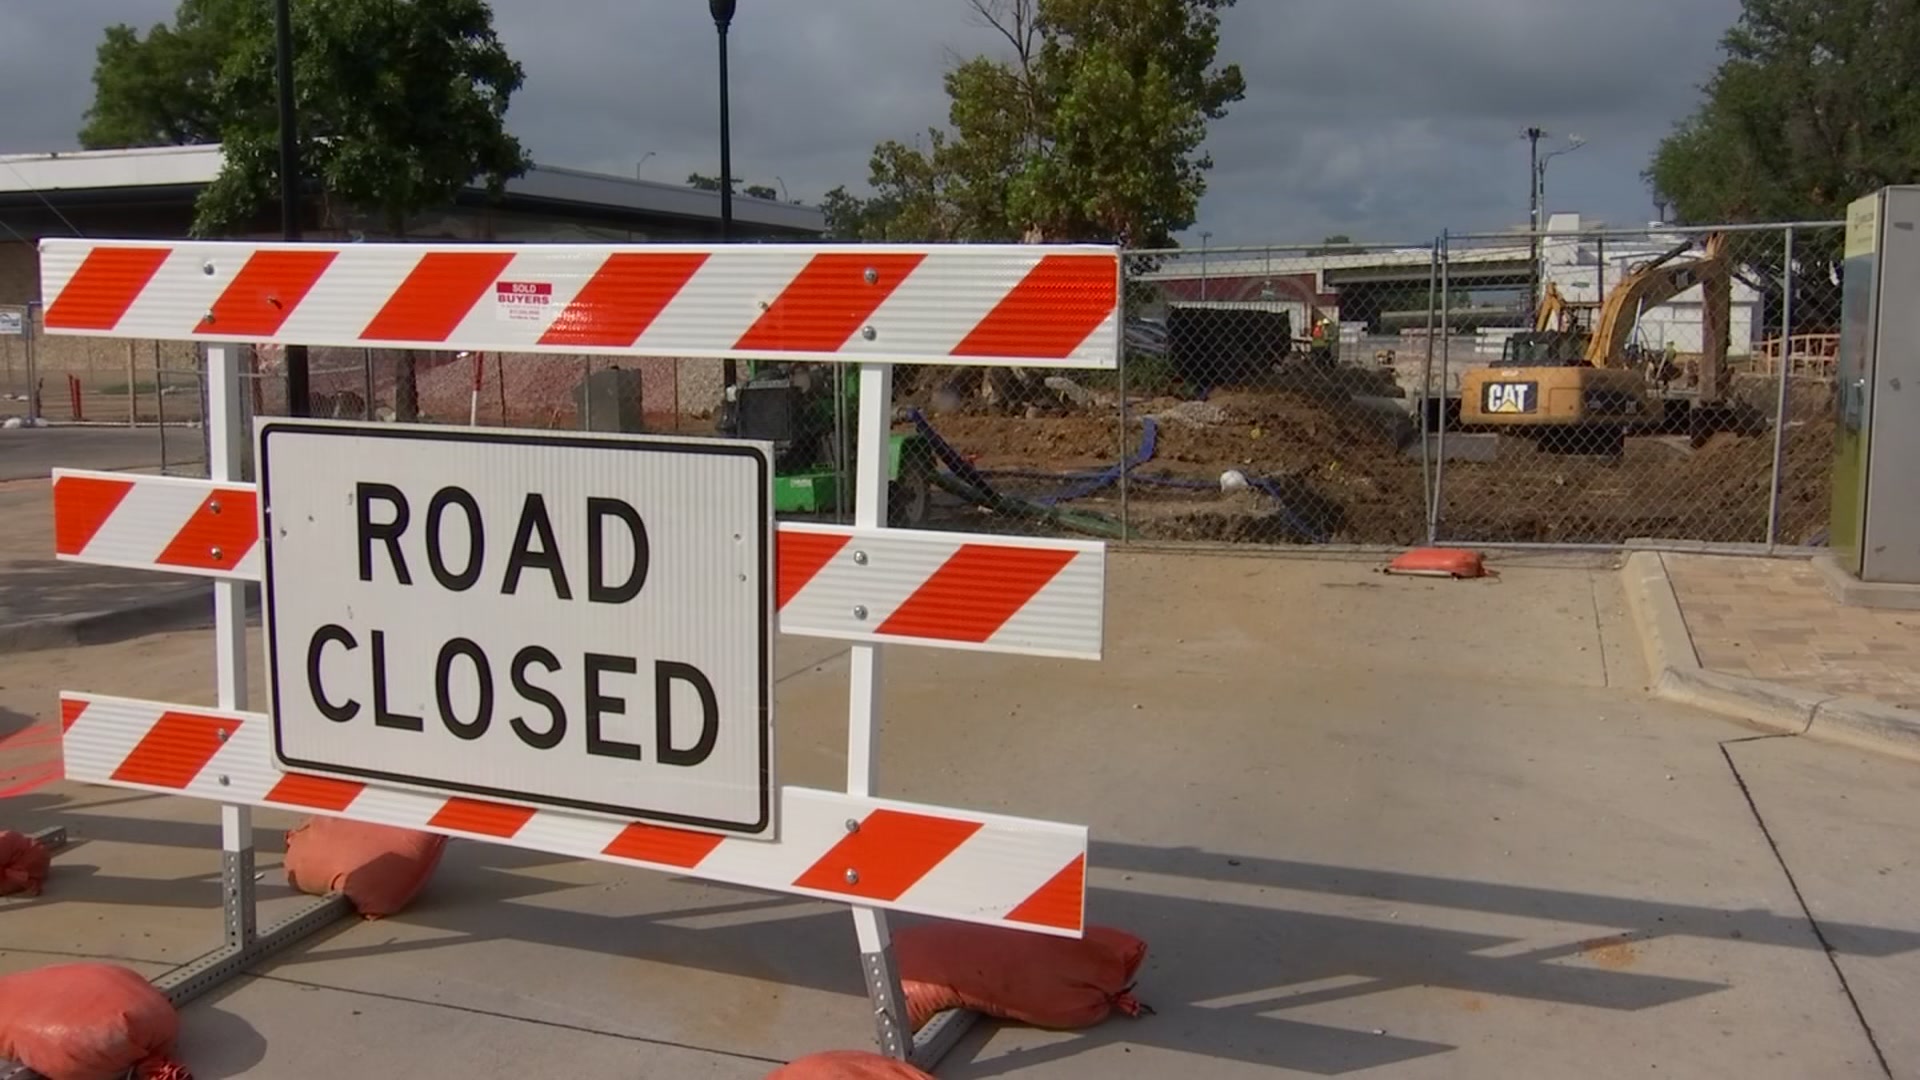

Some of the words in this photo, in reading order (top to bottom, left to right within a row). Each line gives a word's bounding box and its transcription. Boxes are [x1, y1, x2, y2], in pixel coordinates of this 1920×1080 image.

[498, 294, 549, 304] BUYERS
[512, 283, 537, 293] SOLD
[1488, 383, 1528, 413] CAT
[356, 481, 650, 605] ROAD
[306, 623, 720, 767] CLOSED
